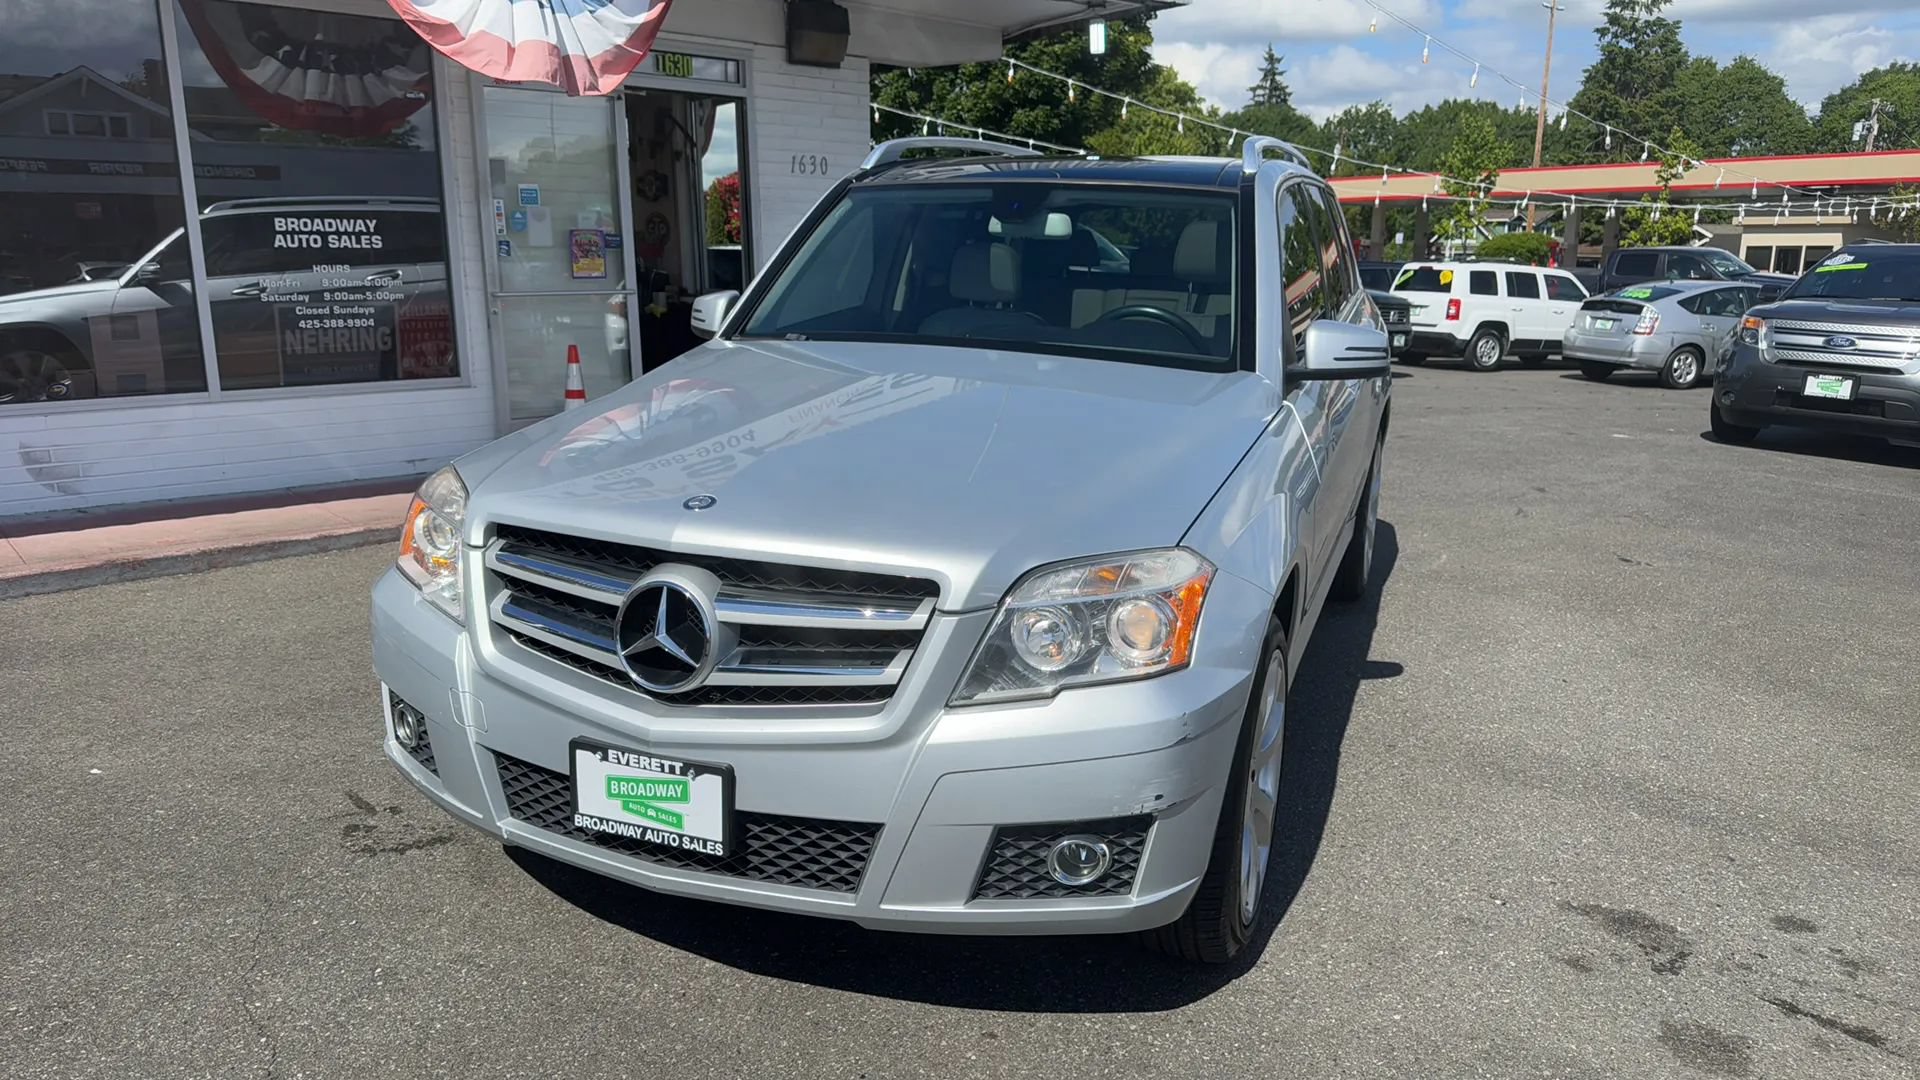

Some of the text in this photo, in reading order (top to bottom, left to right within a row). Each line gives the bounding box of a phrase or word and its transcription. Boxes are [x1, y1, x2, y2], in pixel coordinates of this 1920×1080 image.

[656, 53, 693, 78] 1630
[791, 154, 828, 175] 1630
[274, 217, 377, 233] BROADWAY
[274, 234, 383, 249] AUTO SALES
[312, 264, 351, 273] HOURS
[259, 278, 300, 288] Mon-Fri
[260, 291, 405, 303] Saturday 9:00am-5:00pm
[295, 305, 375, 316] Closed Sundays
[298, 318, 375, 328] 425-388-9904
[285, 326, 392, 355] NEHRING
[608, 749, 684, 775] EVERETT
[610, 780, 684, 798] BROADWAY
[628, 802, 678, 824] AUTO SALES
[574, 814, 724, 856] BROADWAY AUTO SALES
